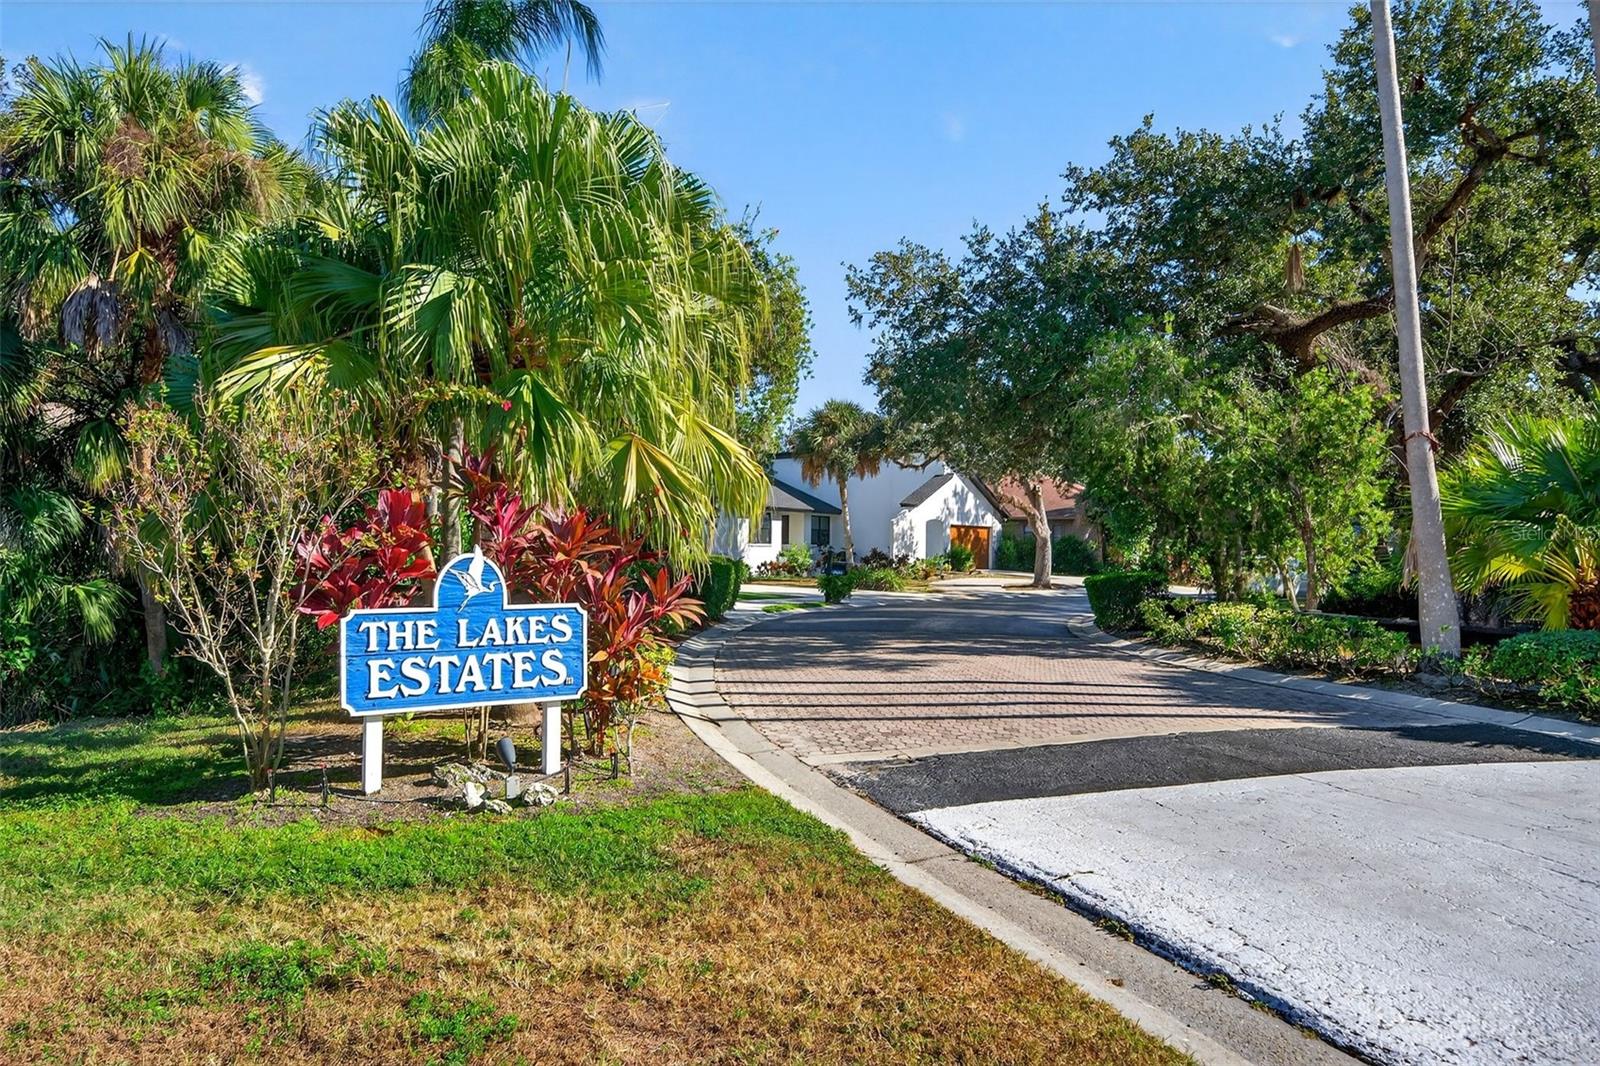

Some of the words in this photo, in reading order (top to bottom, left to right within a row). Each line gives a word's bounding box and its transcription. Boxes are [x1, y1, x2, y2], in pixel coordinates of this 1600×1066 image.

[358, 619, 441, 652] THE
[456, 614, 573, 649] LAKES
[367, 648, 567, 699] ESTATES
